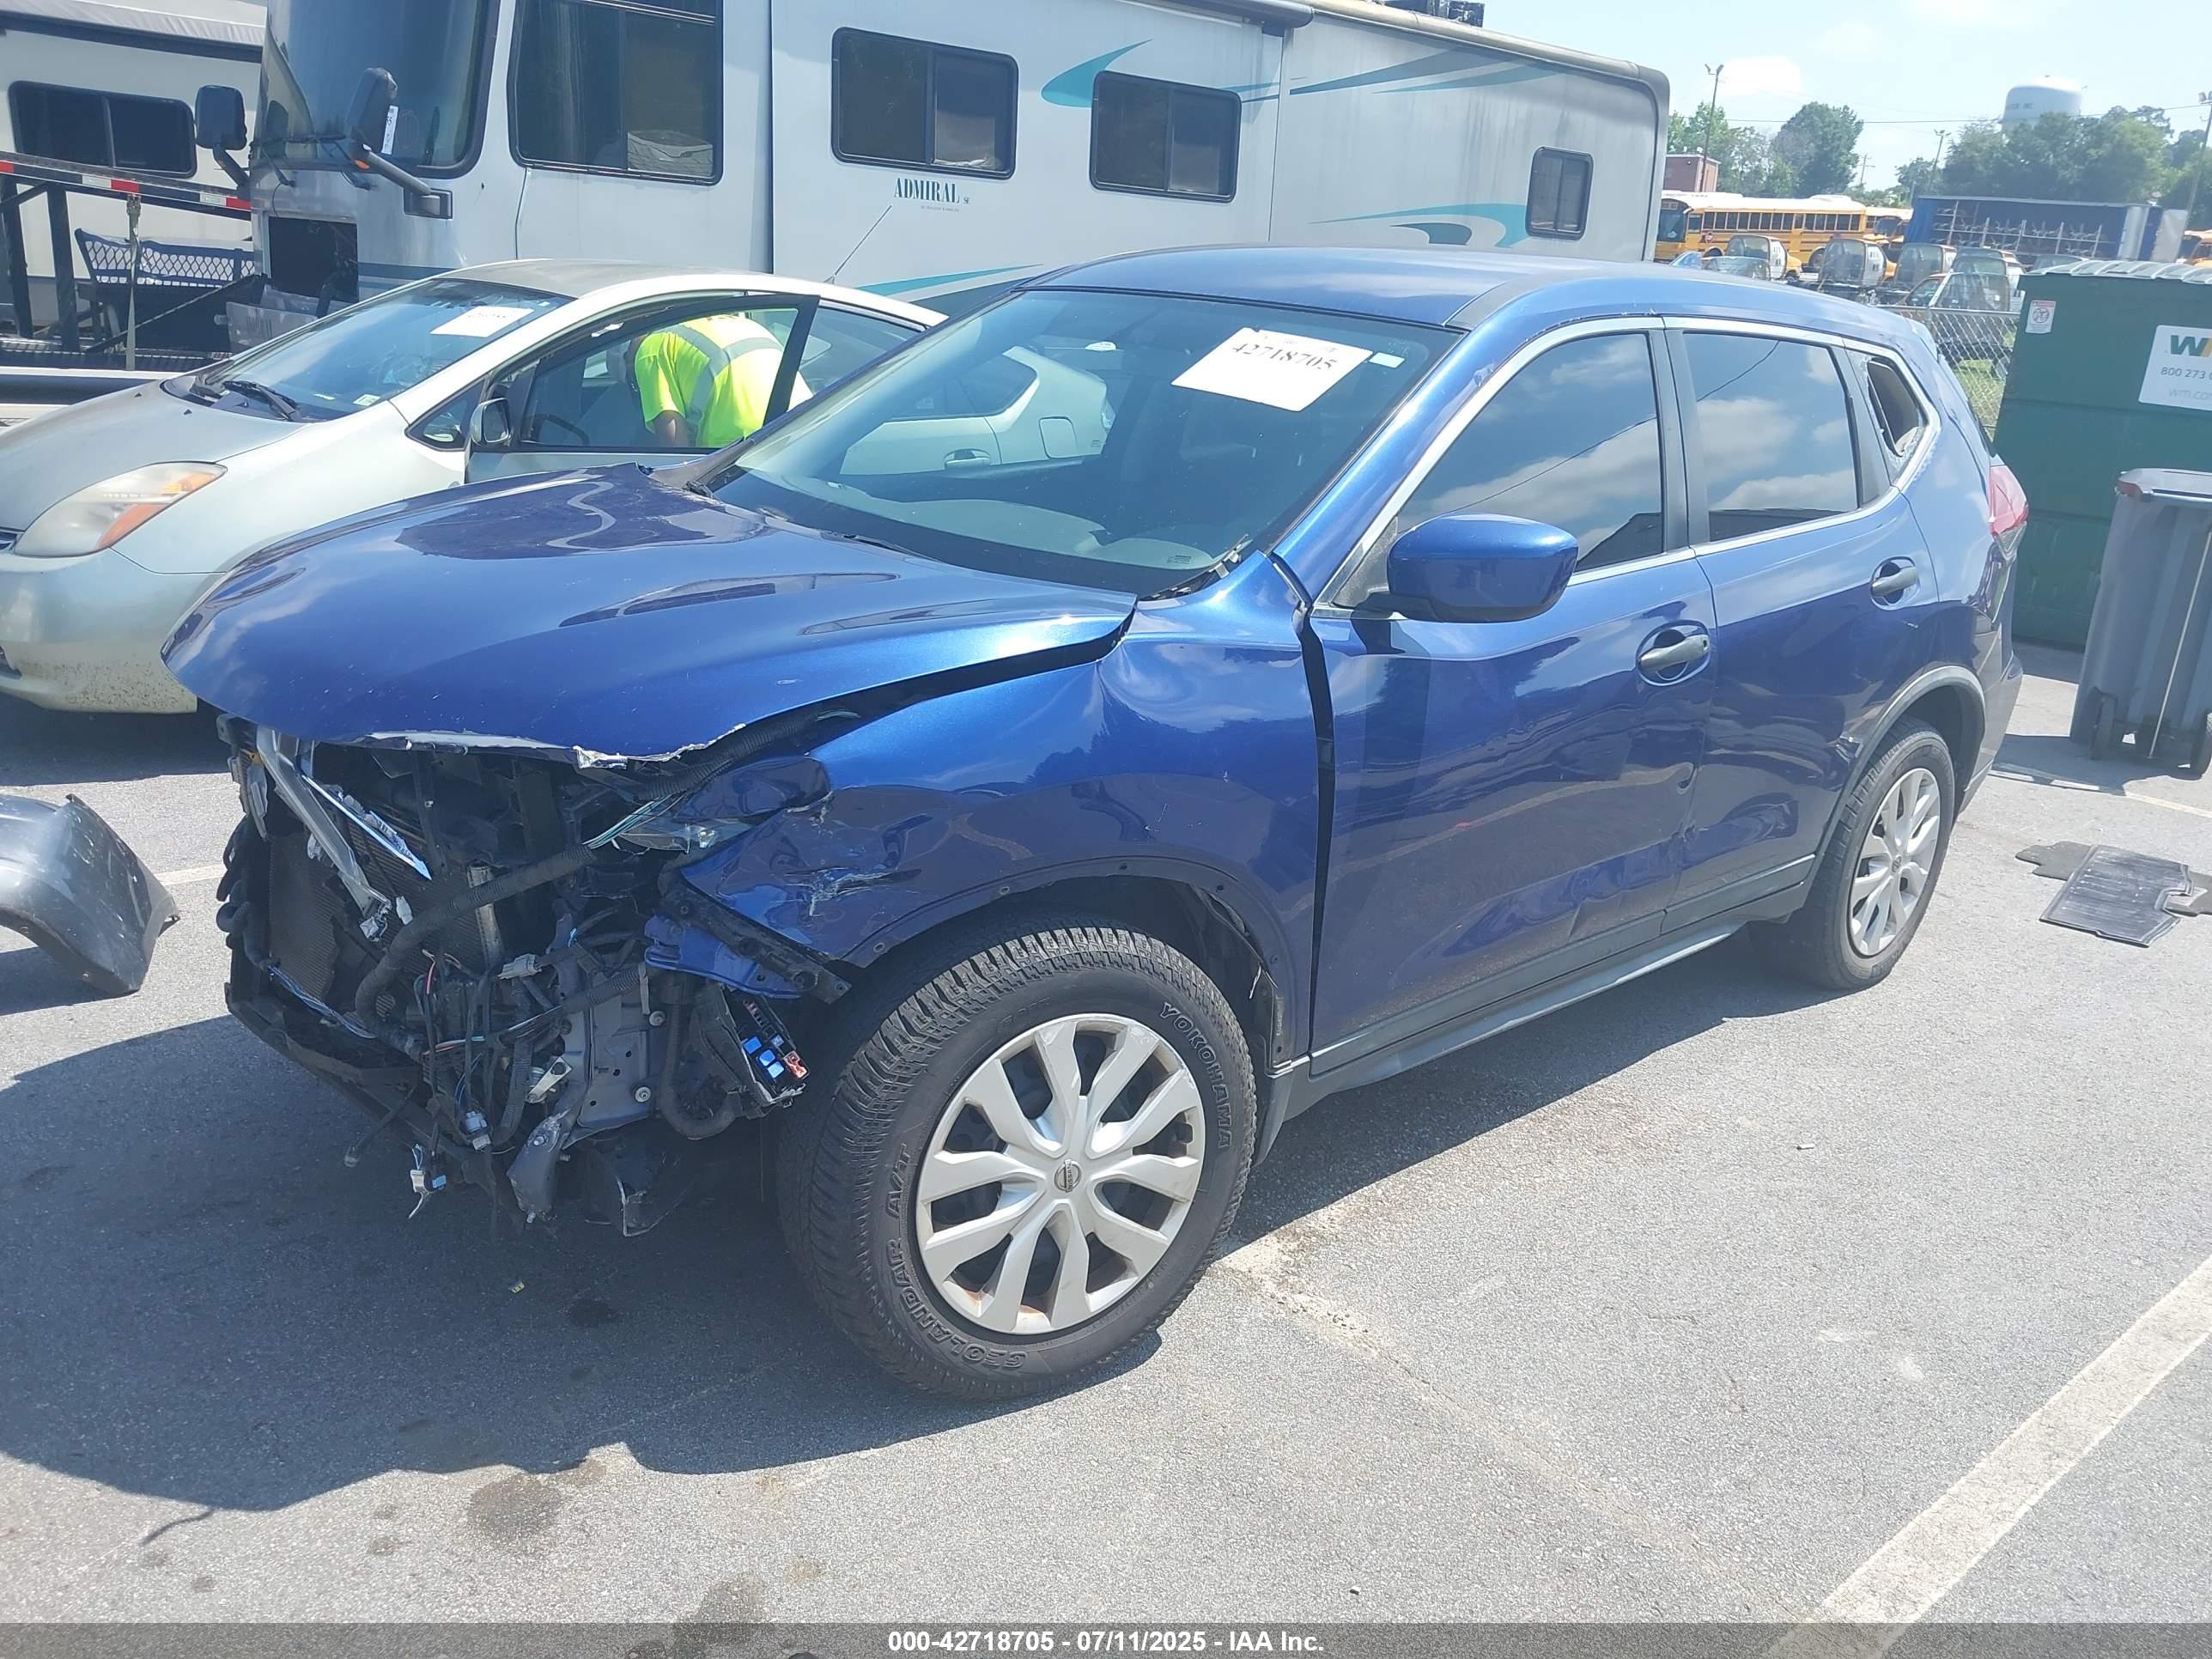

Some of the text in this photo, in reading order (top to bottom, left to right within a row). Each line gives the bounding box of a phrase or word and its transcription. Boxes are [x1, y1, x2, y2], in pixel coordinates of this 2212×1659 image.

[894, 178, 960, 204] ADMIRAL
[1231, 343, 1338, 370] 42718705
[2160, 366, 2183, 377] 800
[2184, 368, 2207, 380] 273
[1159, 1001, 1232, 1149] YOKOHAMA
[886, 1239, 1029, 1368] GEOLANDAR
